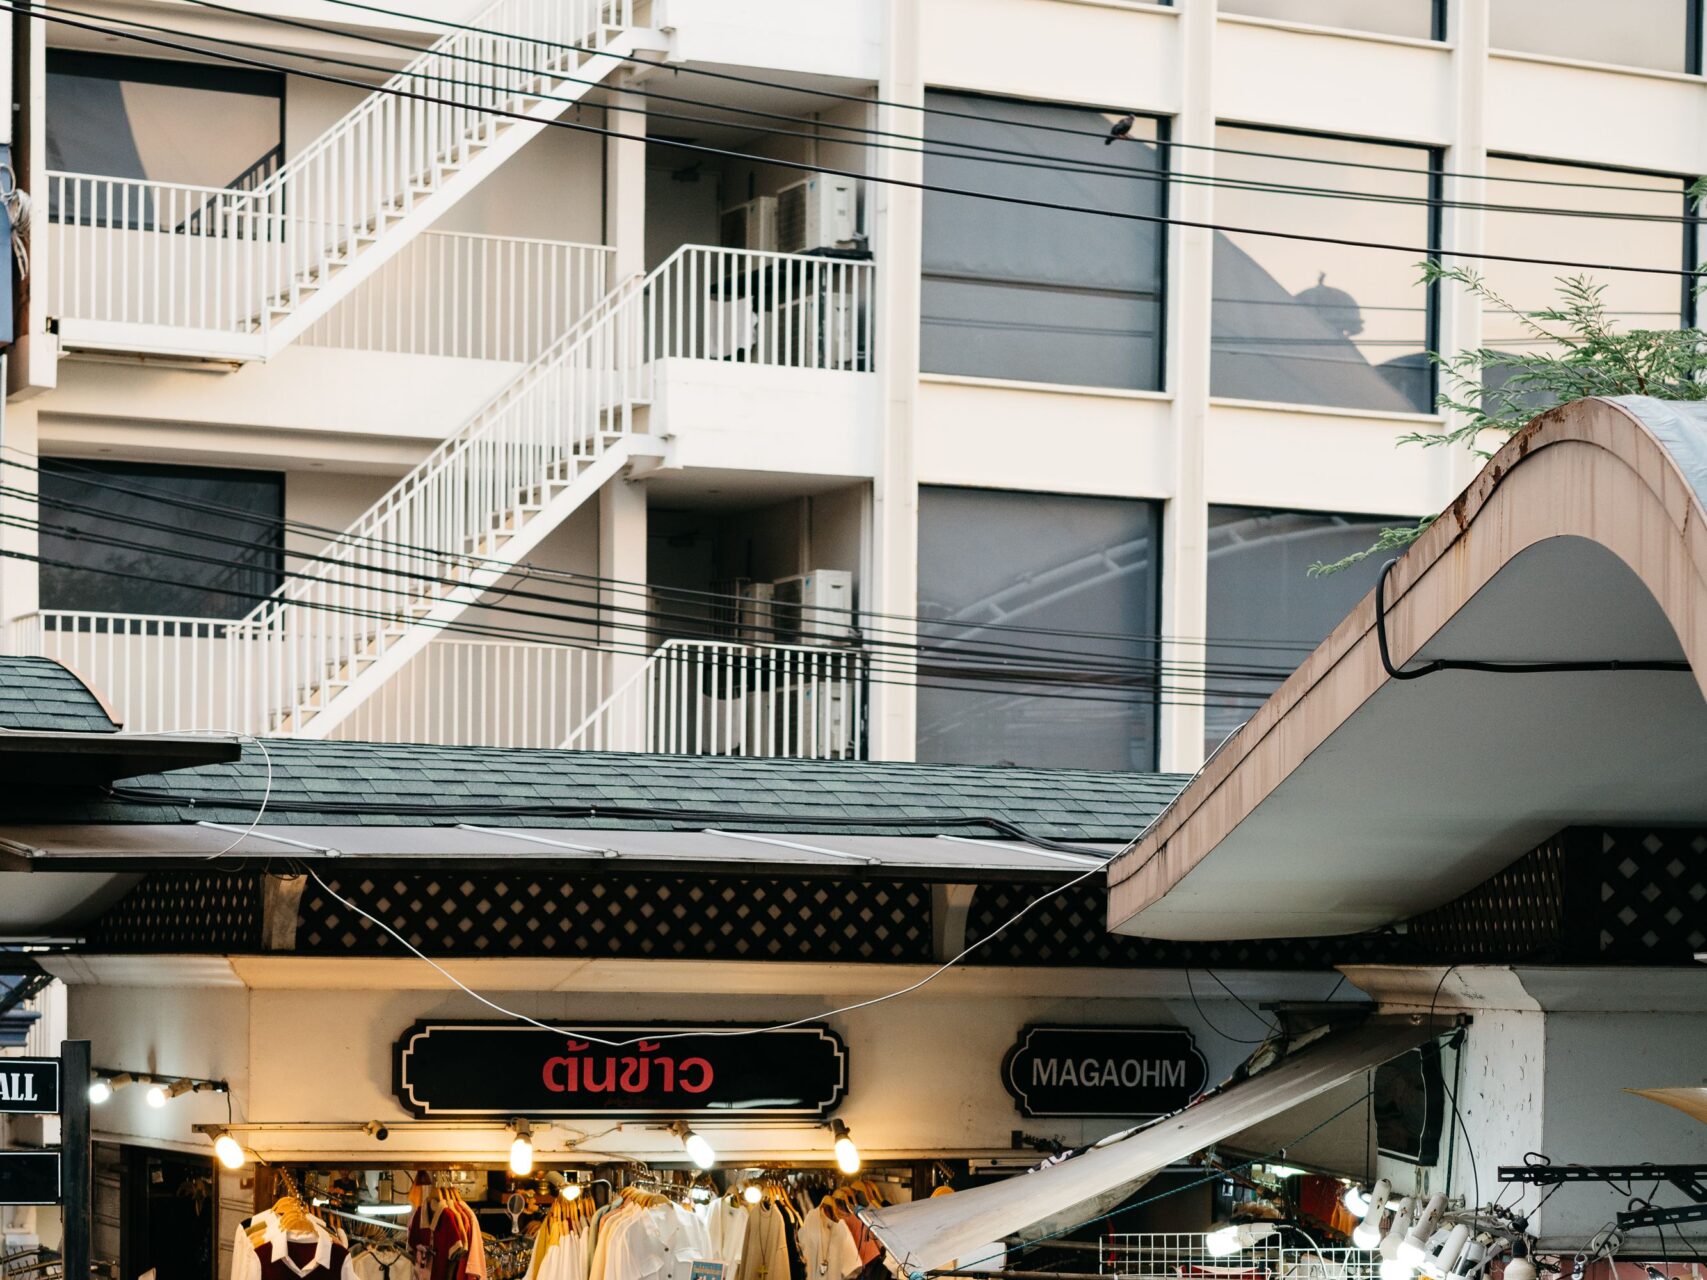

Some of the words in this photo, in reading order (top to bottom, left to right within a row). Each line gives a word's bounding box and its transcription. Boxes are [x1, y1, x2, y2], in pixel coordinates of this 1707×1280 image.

[542, 1040, 714, 1094] ต้นข้าว
[1032, 1058, 1186, 1088] MAGAOHM
